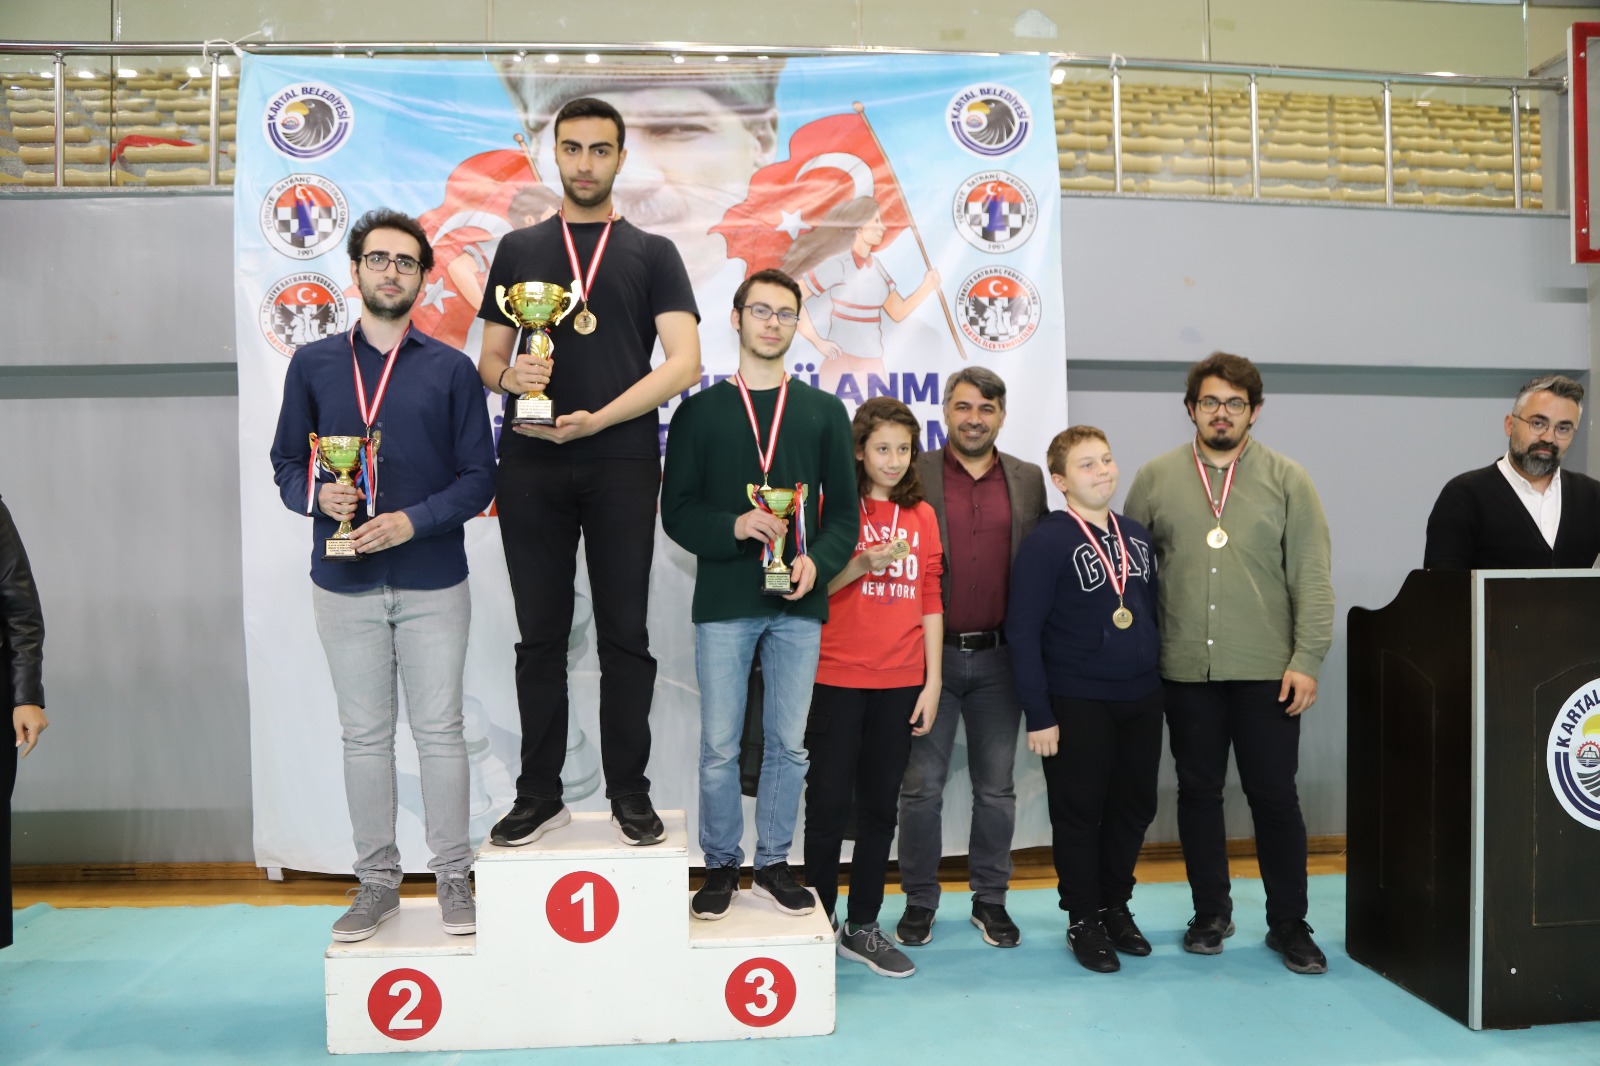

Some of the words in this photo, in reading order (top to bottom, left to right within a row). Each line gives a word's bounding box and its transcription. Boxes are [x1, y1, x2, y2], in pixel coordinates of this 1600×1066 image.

[267, 90, 299, 121] KARTAL
[301, 86, 351, 120] BELEDİYESİ
[951, 91, 977, 119] KARTAL
[979, 87, 1029, 119] BELEDİYESİ
[967, 173, 1001, 187] SATRANÇ
[264, 195, 276, 230] TÜRKİYE
[276, 176, 312, 194] SATRANÇ
[317, 179, 347, 229] FEDERASYONU
[973, 268, 1003, 280] SATRANÇ
[263, 286, 282, 314] TÜRKİYE
[280, 274, 312, 288] SATRANÇ
[313, 275, 345, 312] FEDERASYONU
[962, 322, 981, 344] KARTAL
[862, 581, 886, 596] NEW
[889, 583, 916, 600] YORK
[1556, 689, 1600, 748] KARTAL
[570, 882, 595, 932] 1
[388, 979, 423, 1030] 2
[744, 967, 778, 1017] 3
